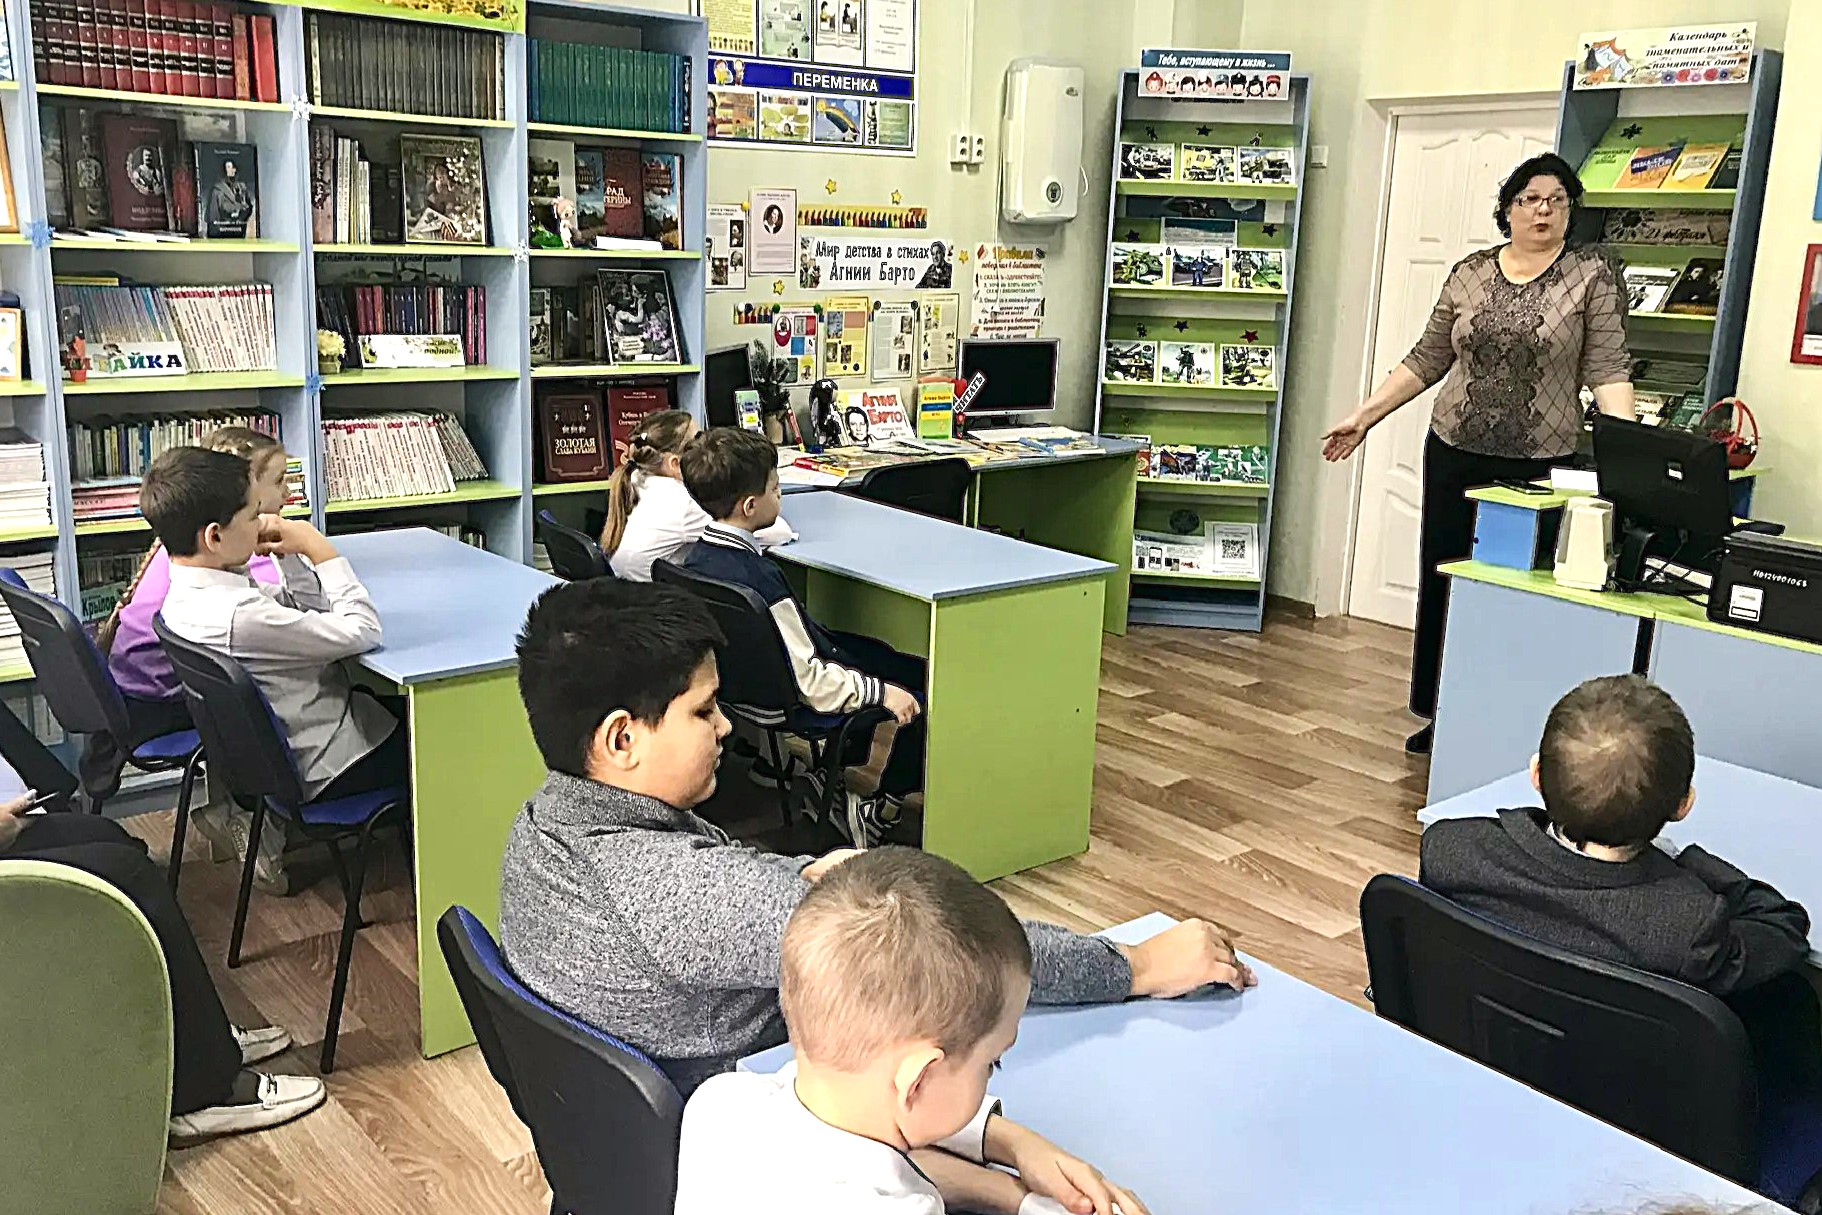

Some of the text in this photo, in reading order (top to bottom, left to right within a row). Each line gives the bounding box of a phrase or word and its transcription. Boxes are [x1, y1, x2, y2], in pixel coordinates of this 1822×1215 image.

[1669, 30, 1727, 42] Календарь
[1646, 44, 1740, 57] знаменательных
[1180, 56, 1234, 69] вступающему
[1235, 58, 1240, 66] в
[1241, 58, 1266, 67] жизнь
[1652, 58, 1738, 69] памятных дат
[793, 72, 878, 92] ПЕРЕМЕНКА
[605, 186, 624, 195] РАД
[815, 241, 930, 260] Мир детства в стихах
[829, 261, 916, 285] Агнии Барто
[954, 376, 984, 411] ЧИТАТЬ
[555, 437, 595, 448] ЗОЛОТАЯ
